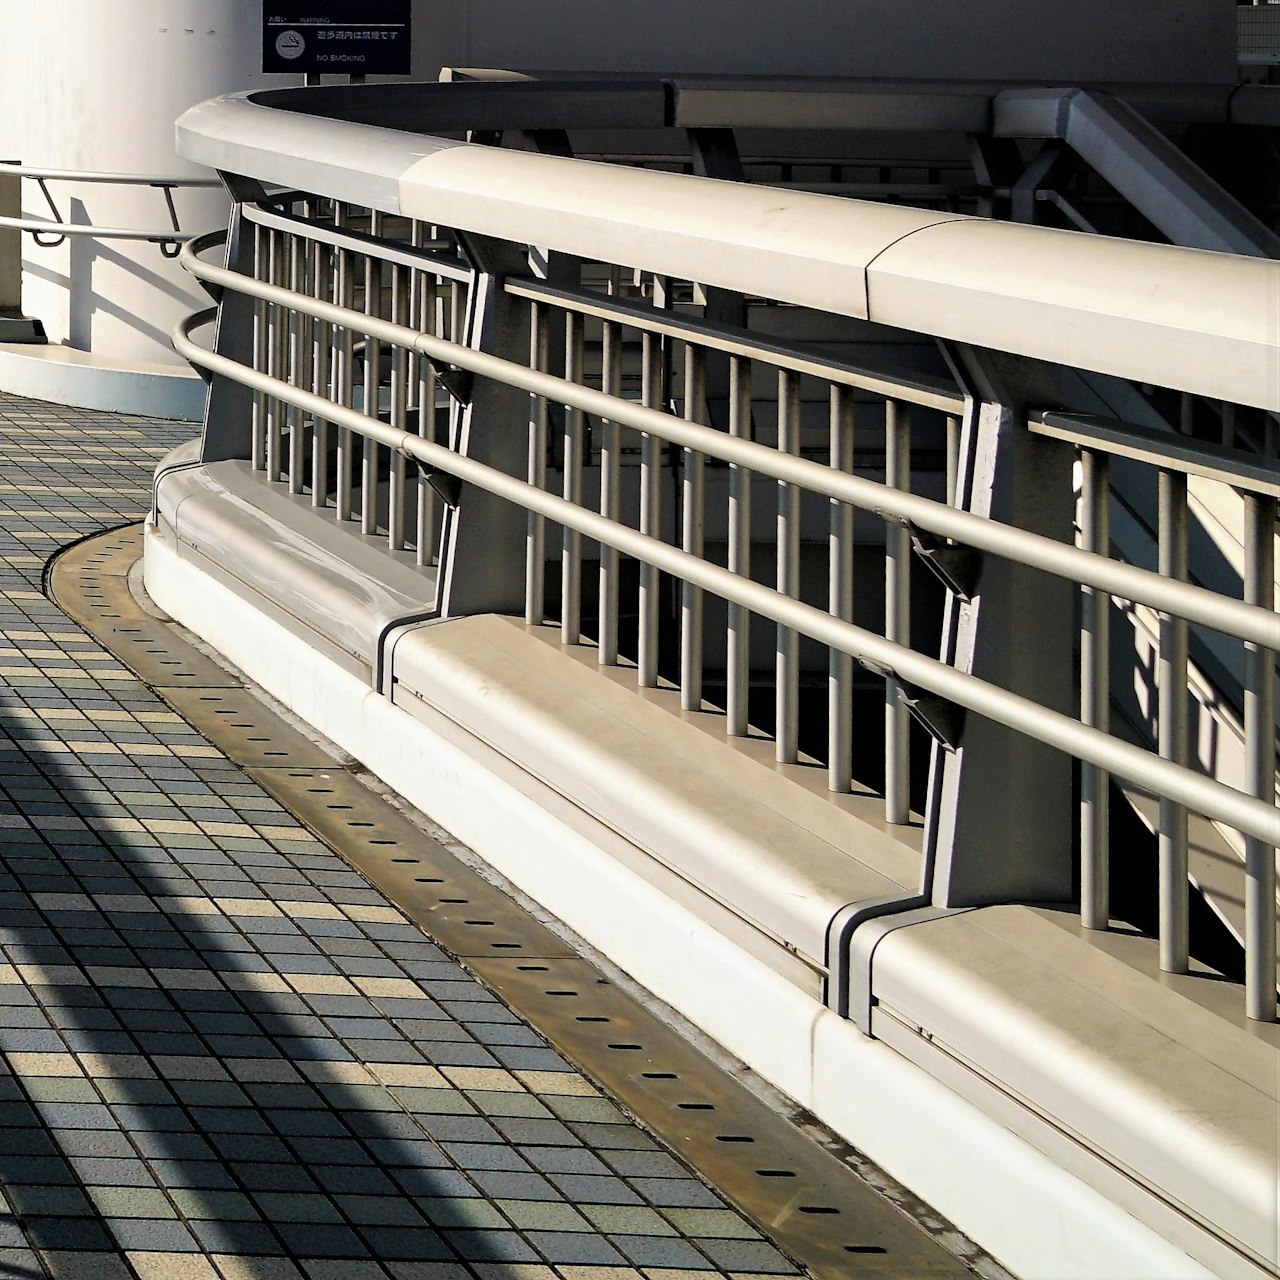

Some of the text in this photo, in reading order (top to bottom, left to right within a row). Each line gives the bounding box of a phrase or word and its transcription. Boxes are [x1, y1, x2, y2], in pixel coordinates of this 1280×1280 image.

[317, 31, 398, 40] 遊歩道内は禁煙です
[316, 54, 366, 62] NO SMOKING
